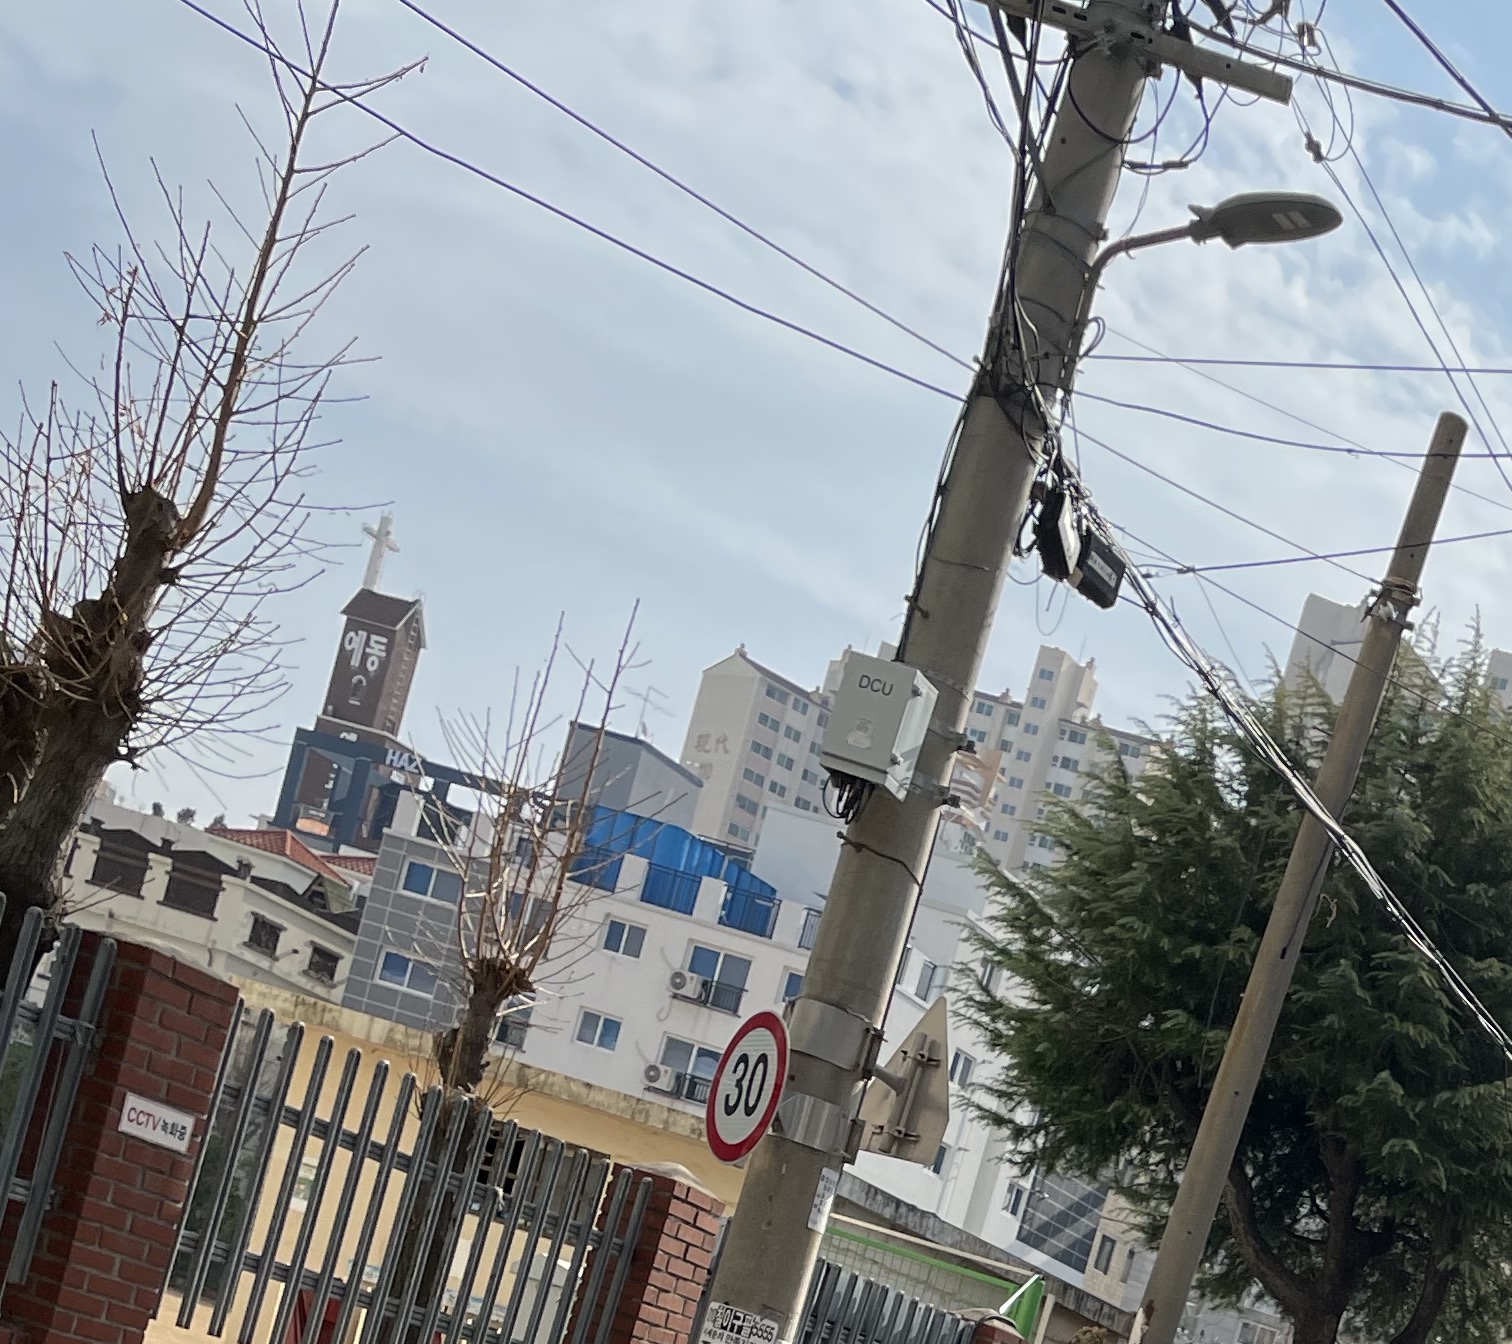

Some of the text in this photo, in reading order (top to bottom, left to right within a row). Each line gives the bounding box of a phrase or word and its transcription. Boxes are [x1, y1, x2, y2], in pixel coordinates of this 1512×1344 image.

[858, 674, 894, 697] DCU
[724, 1052, 769, 1117] 30
[127, 1106, 161, 1131] CCTV
